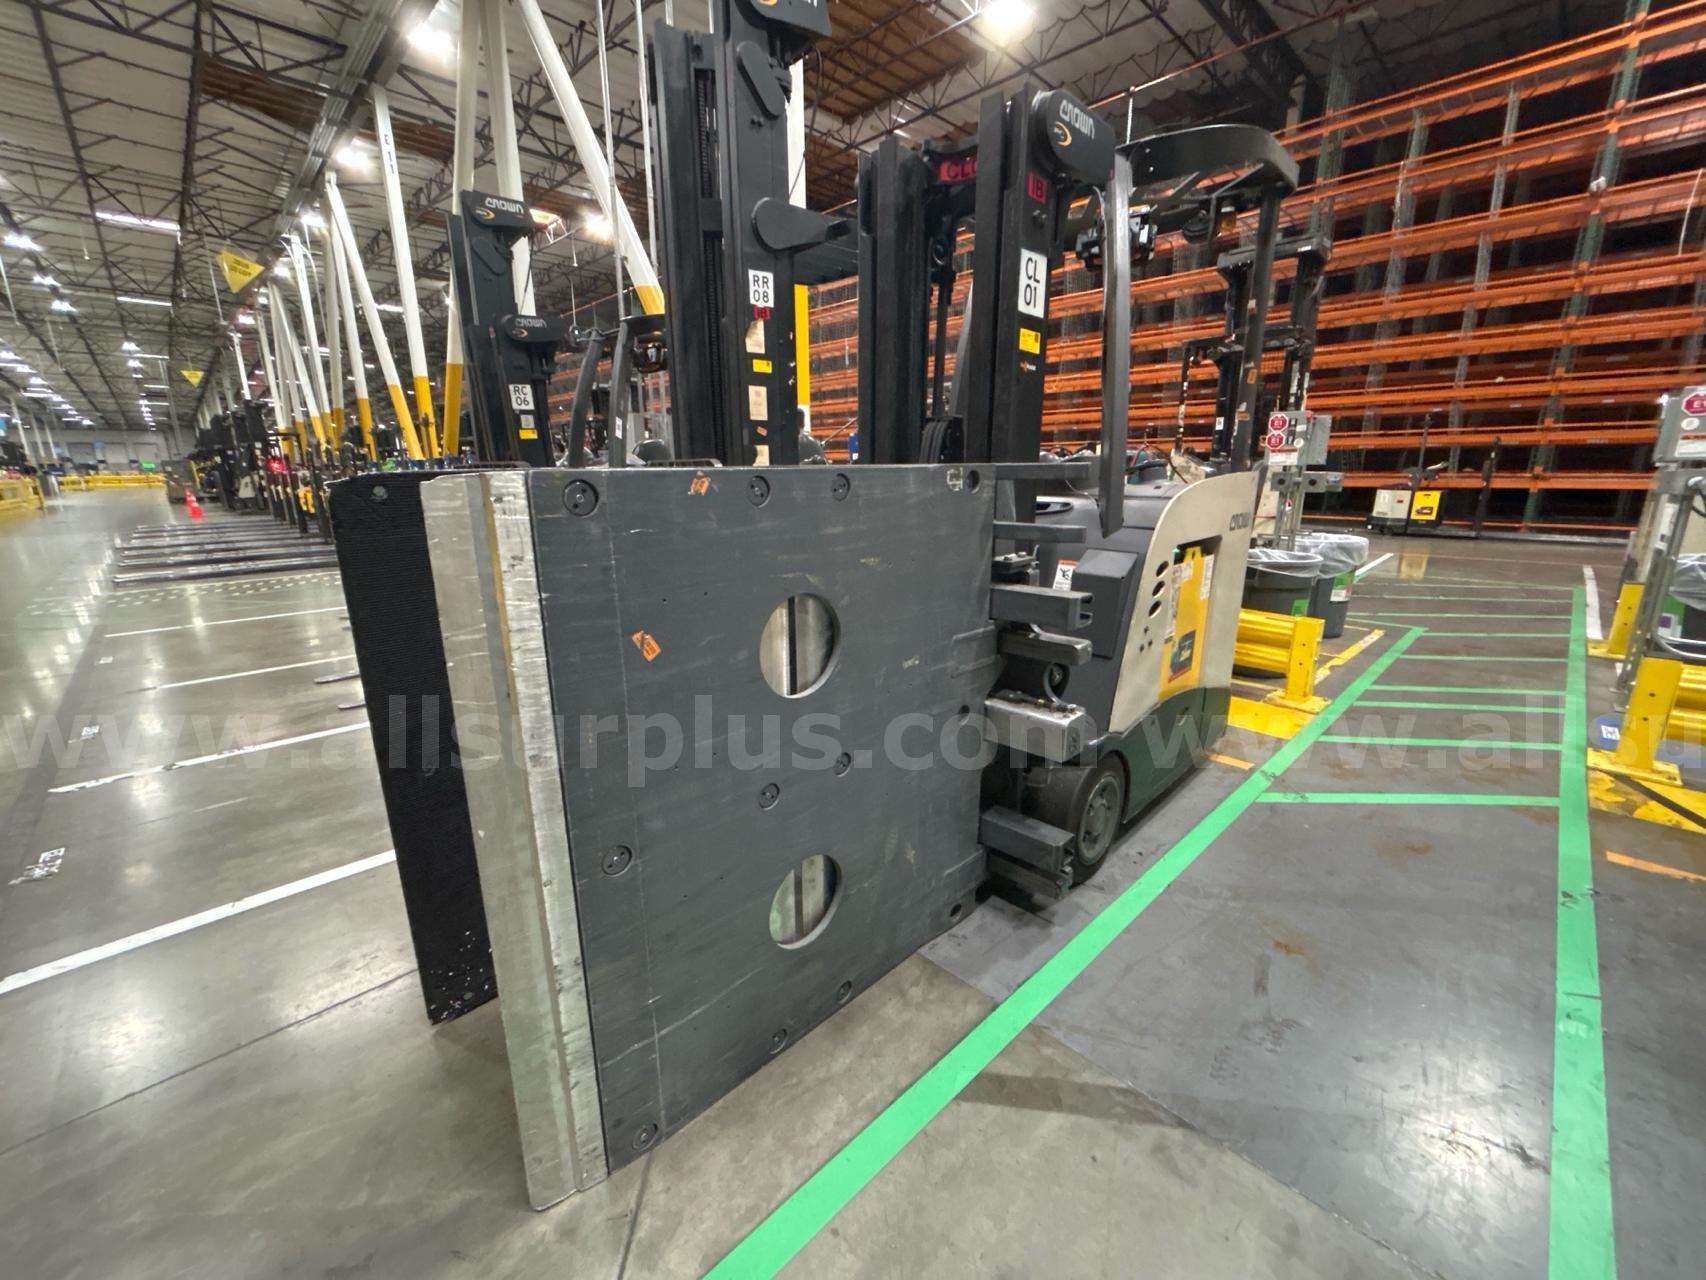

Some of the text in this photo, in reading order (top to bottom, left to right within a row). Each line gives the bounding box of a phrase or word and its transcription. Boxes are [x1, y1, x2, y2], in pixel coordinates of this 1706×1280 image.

[1059, 99, 1095, 140] CROWN
[947, 159, 977, 179] CL
[485, 197, 524, 214] CROWN
[1025, 257, 1041, 283] CL
[752, 275, 769, 290] RR
[753, 289, 769, 303] 08
[1023, 283, 1037, 309] 01
[515, 318, 547, 328] CROWN
[513, 386, 528, 396] RC
[515, 396, 530, 406] 06
